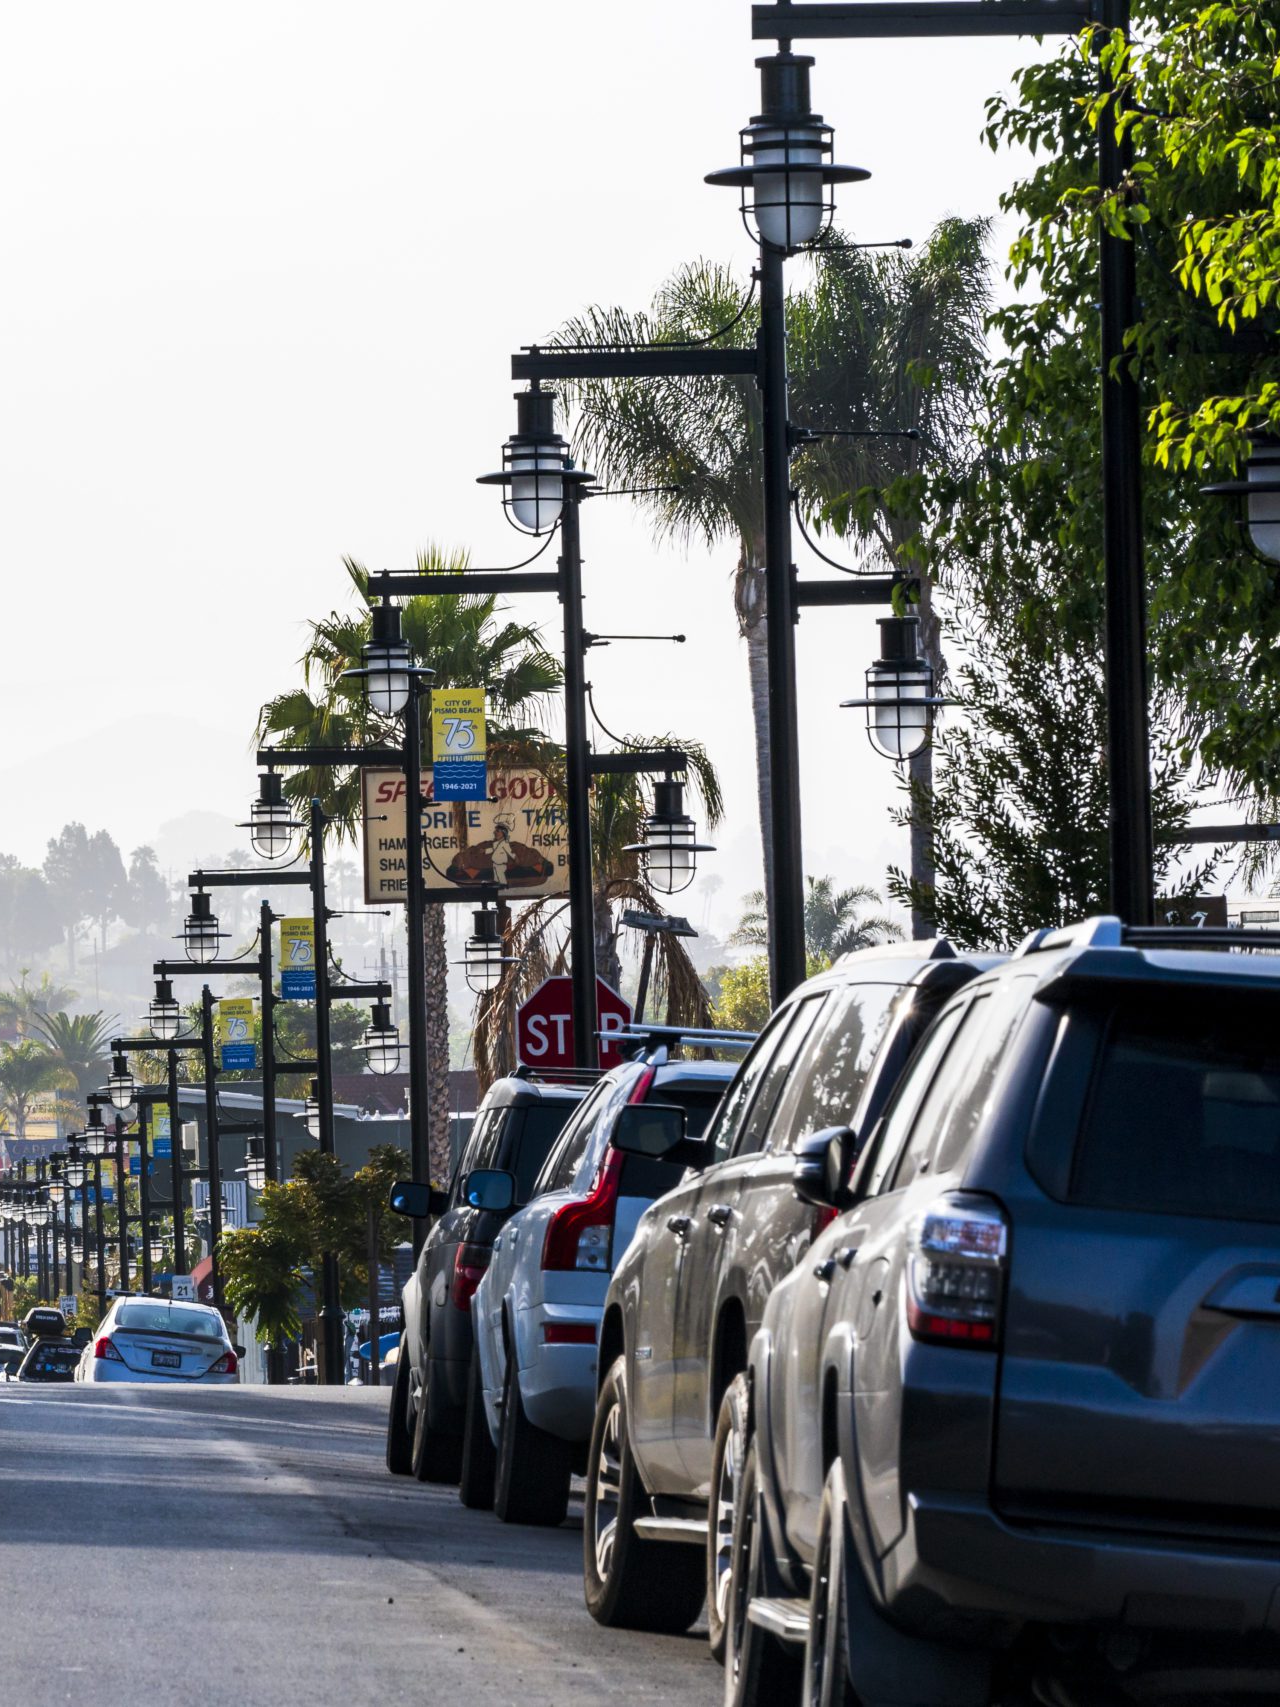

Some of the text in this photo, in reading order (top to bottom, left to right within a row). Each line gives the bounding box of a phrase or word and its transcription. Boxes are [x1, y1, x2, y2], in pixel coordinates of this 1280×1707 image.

[421, 811, 481, 829] DRIE
[380, 879, 408, 891] FRIE
[526, 1012, 625, 1056] STP
[177, 1285, 188, 1296] 21
